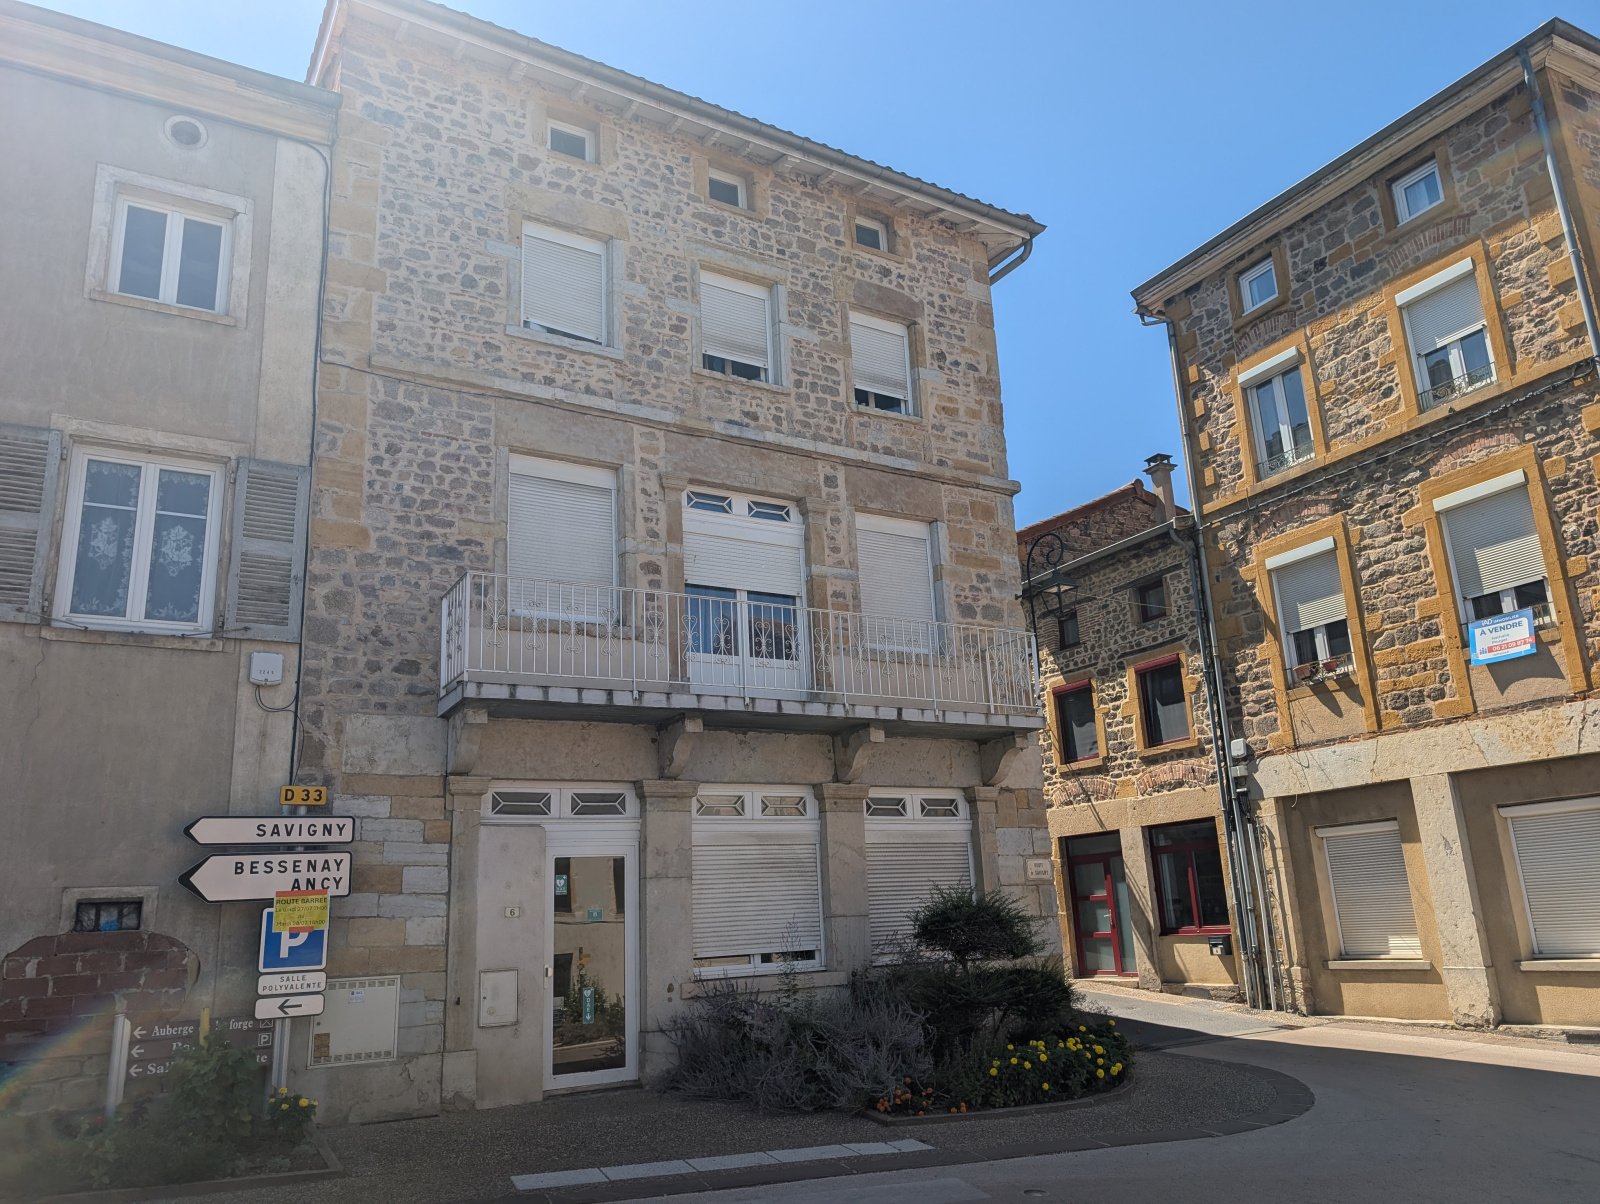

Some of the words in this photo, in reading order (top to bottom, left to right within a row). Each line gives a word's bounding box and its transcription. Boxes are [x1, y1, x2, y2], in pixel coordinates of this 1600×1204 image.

[1488, 620, 1523, 633] VENDRE
[284, 789, 294, 802] D
[301, 788, 323, 801] 33
[256, 823, 347, 837] SAVIGNY
[234, 858, 344, 875] BESSENAY
[291, 876, 343, 891] ANCY
[510, 909, 516, 917] 6
[280, 974, 307, 982] SALLE
[262, 982, 322, 992] POLYVALENTE
[151, 1024, 194, 1037] Auberge
[229, 1018, 254, 1030] forge
